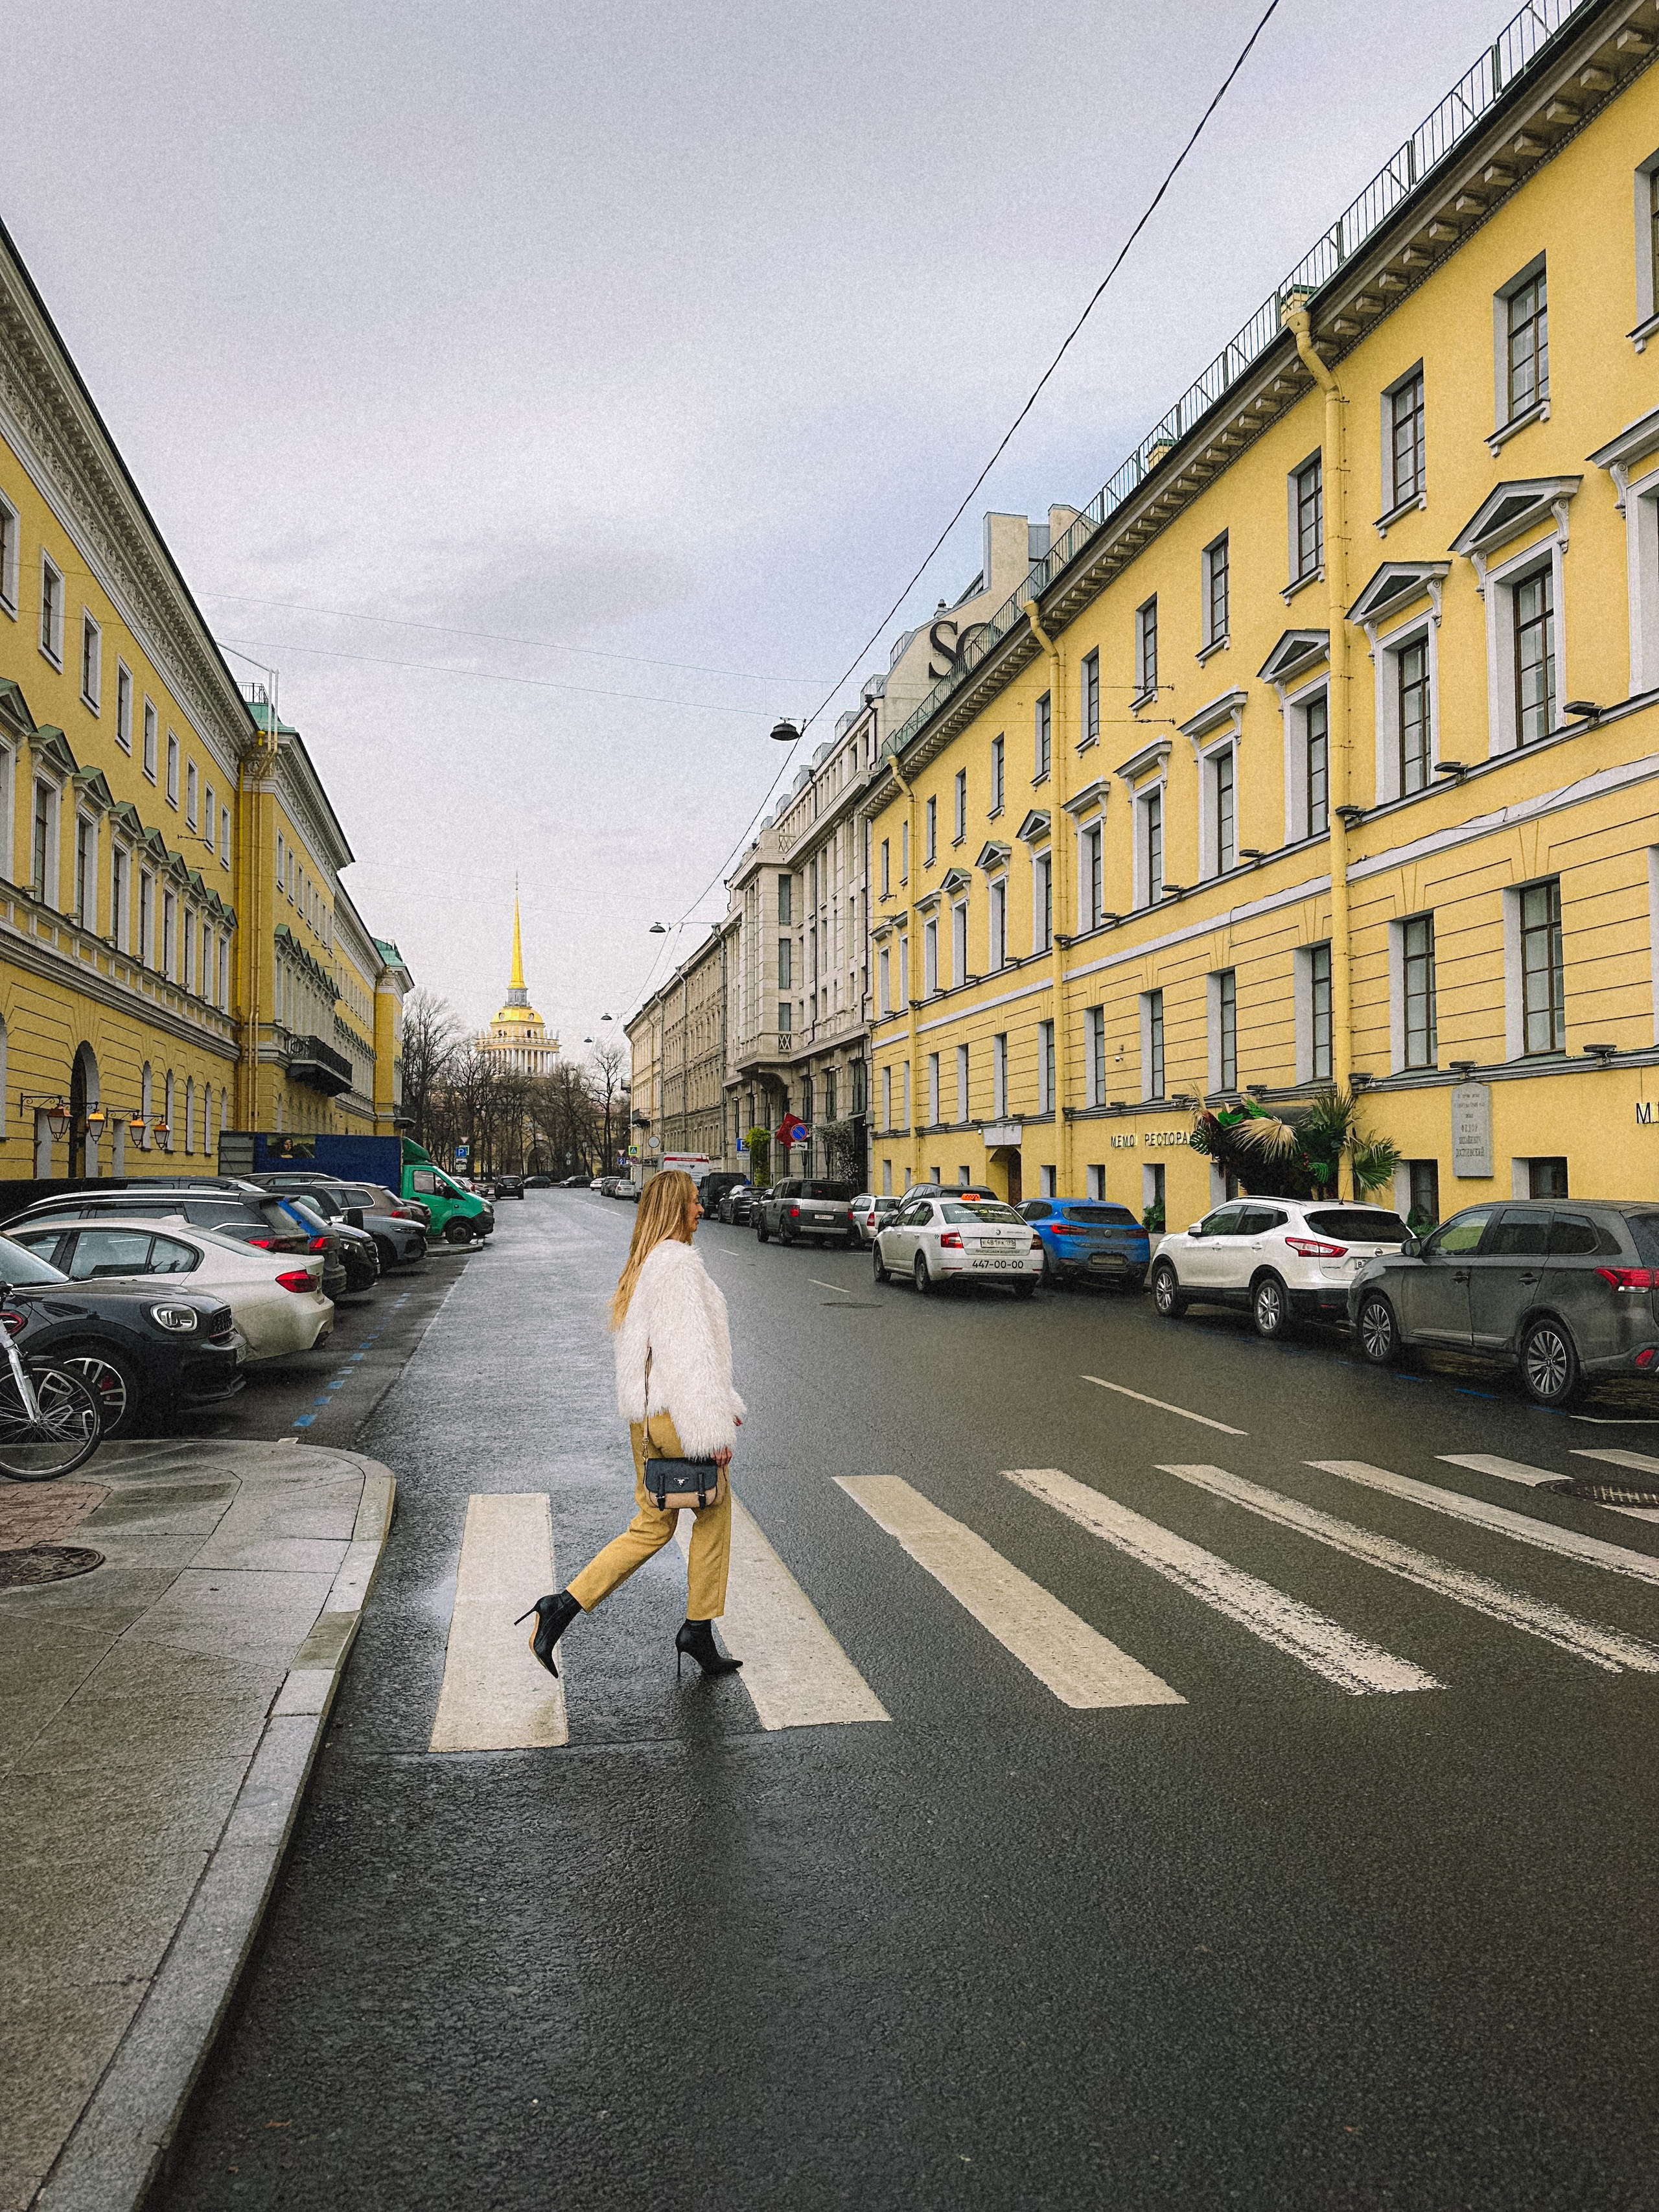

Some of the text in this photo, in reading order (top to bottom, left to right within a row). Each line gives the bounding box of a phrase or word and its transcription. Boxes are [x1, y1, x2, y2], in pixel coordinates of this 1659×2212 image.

[1636, 1102, 1659, 1124] М
[1144, 1132, 1192, 1147] РЕСТОРА
[972, 1260, 1024, 1269] 447-00-00
